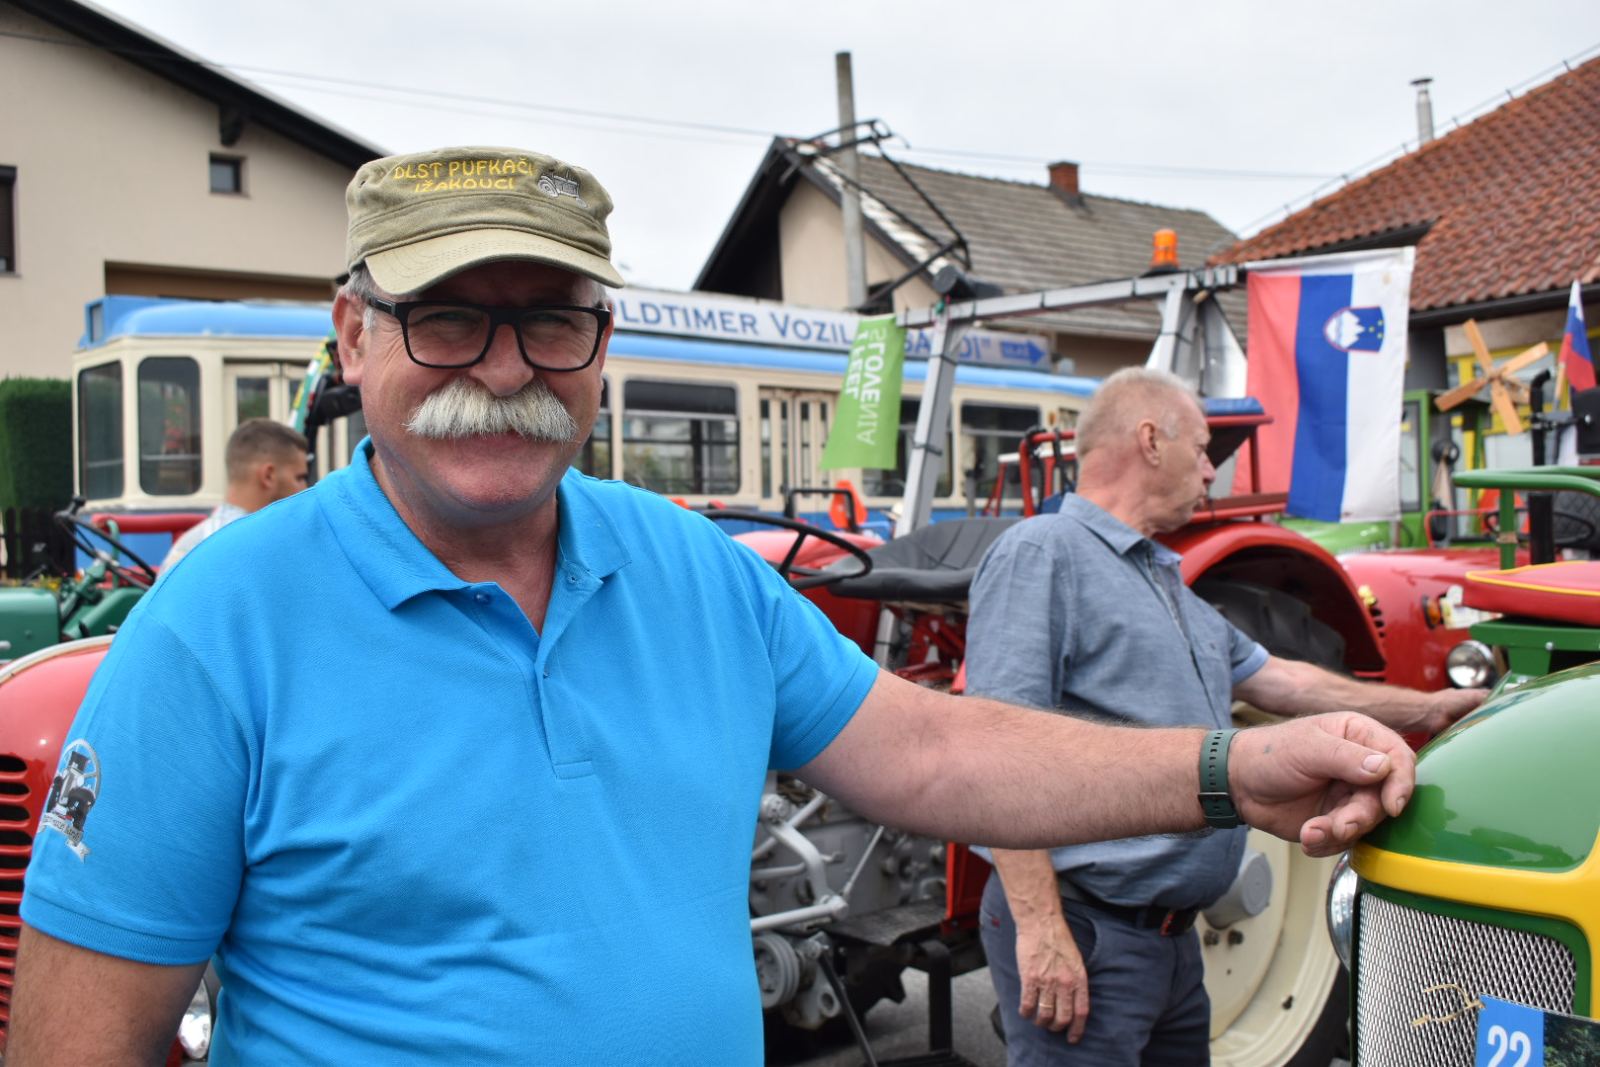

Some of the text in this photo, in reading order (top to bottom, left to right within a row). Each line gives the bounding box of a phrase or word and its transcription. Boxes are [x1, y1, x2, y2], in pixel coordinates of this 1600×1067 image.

[393, 155, 534, 179] DLST PUFKAČI
[613, 300, 757, 335] LDTIMER
[1487, 1025, 1532, 1067] 22
